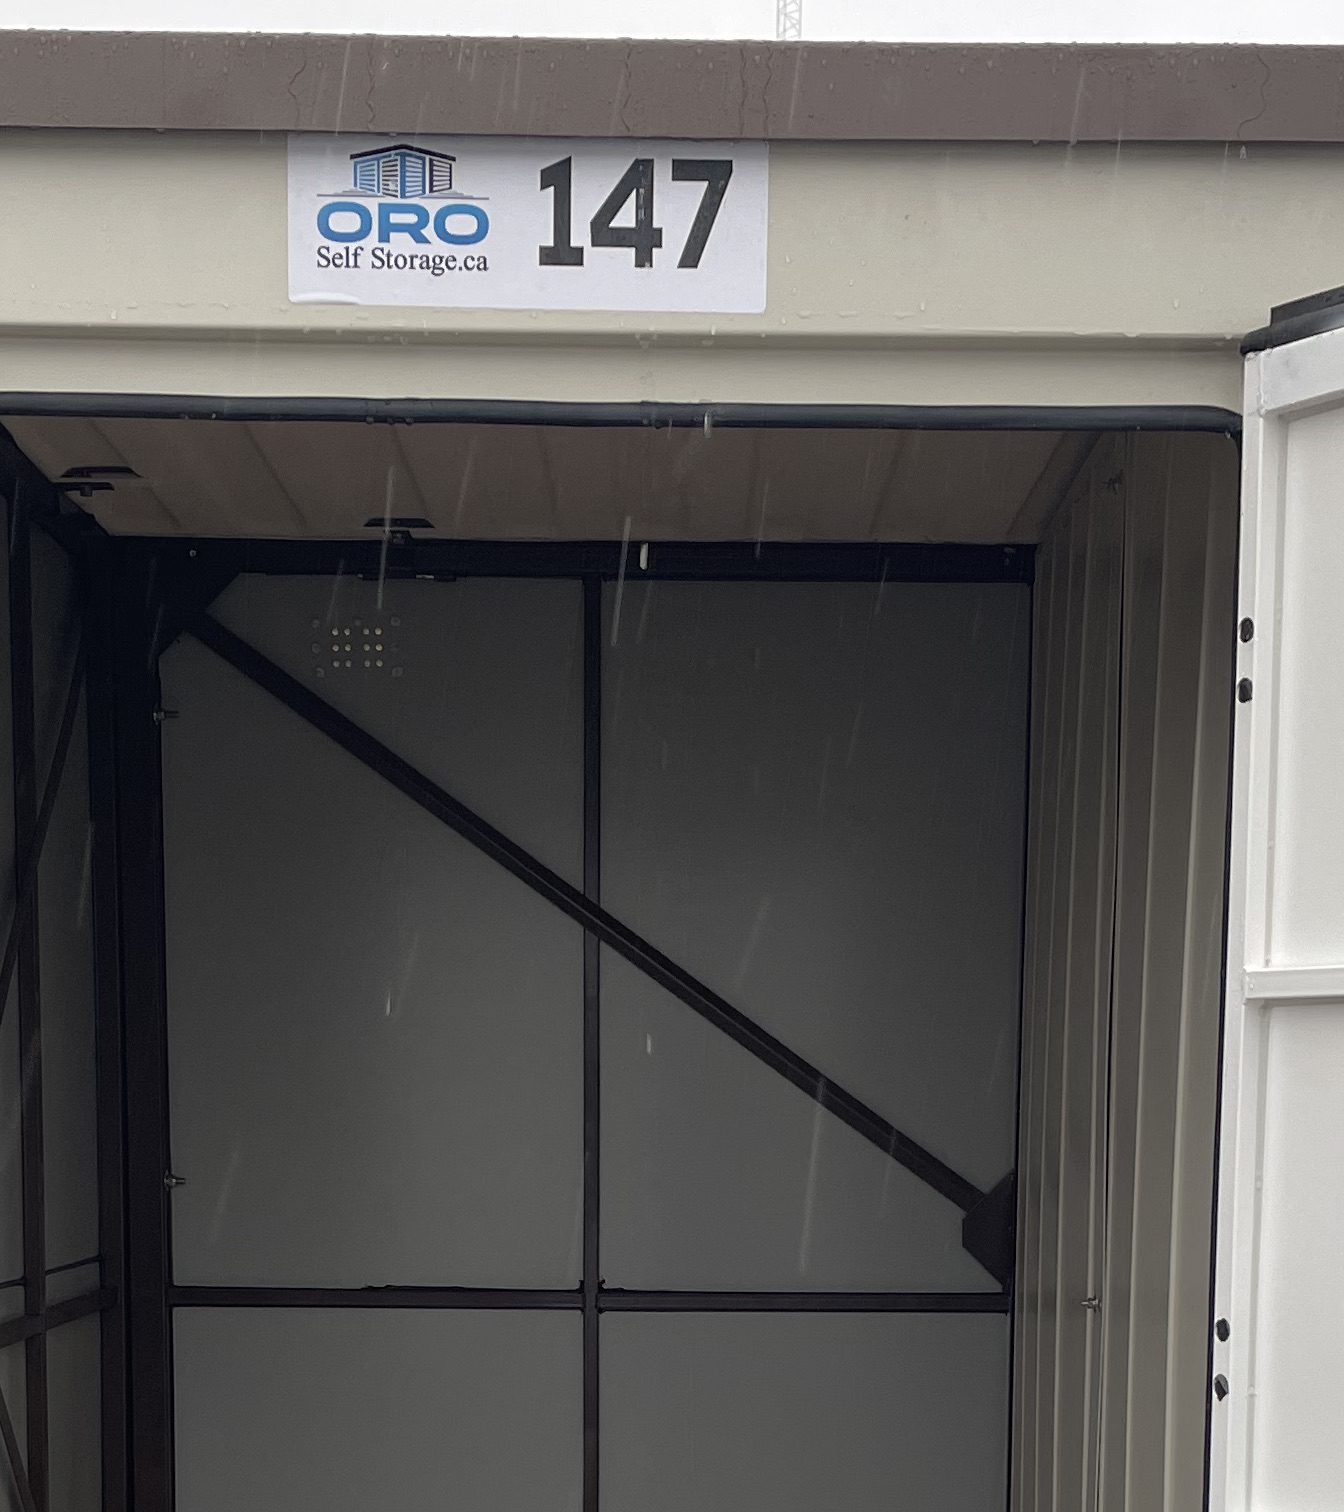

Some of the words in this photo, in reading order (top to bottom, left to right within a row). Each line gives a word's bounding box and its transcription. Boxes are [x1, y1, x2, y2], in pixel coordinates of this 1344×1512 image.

[316, 201, 490, 246] ORO
[538, 155, 734, 270] 147
[316, 246, 362, 270] Self
[370, 246, 489, 277] Storage.ca
